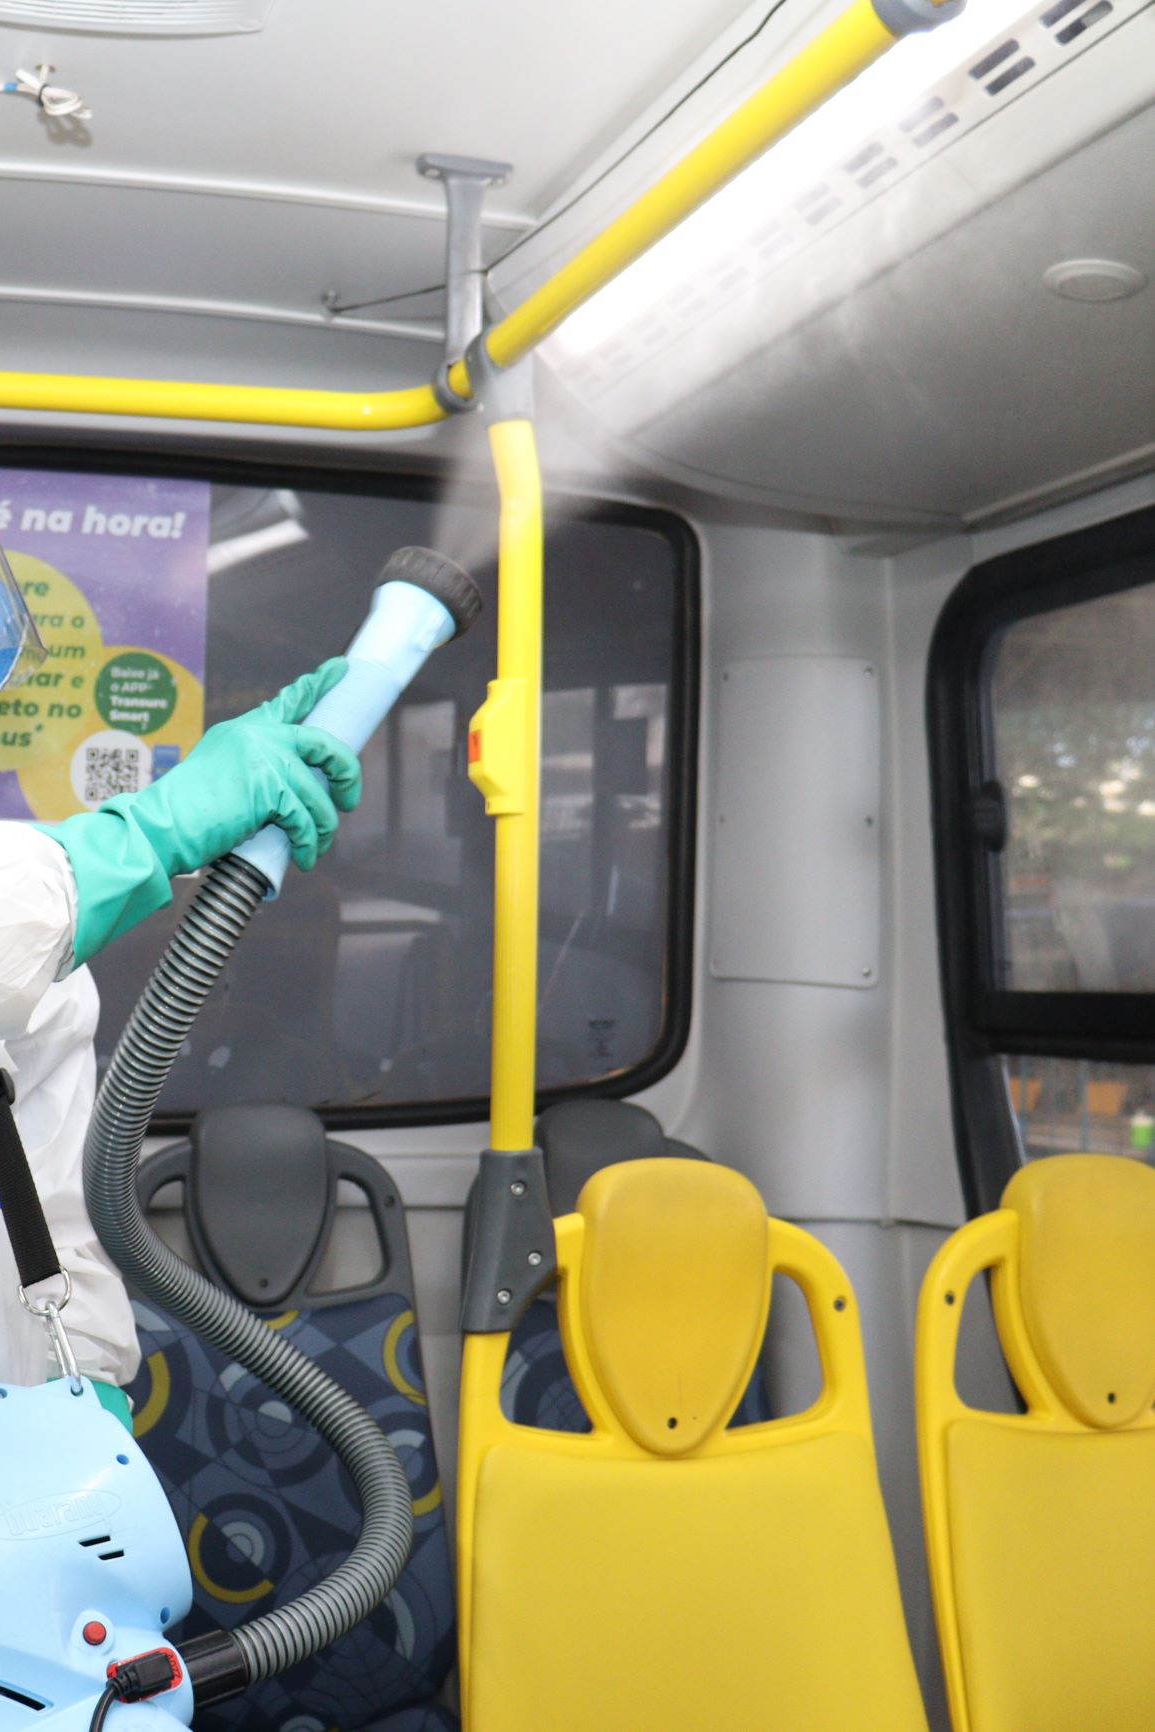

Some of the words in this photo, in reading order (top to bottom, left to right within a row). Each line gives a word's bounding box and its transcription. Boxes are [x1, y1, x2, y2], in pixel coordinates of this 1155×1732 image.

[19, 507, 74, 533] na
[80, 504, 187, 540] hora!
[22, 581, 50, 597] re
[71, 615, 85, 629] o
[71, 675, 85, 688] e
[48, 702, 83, 719] no
